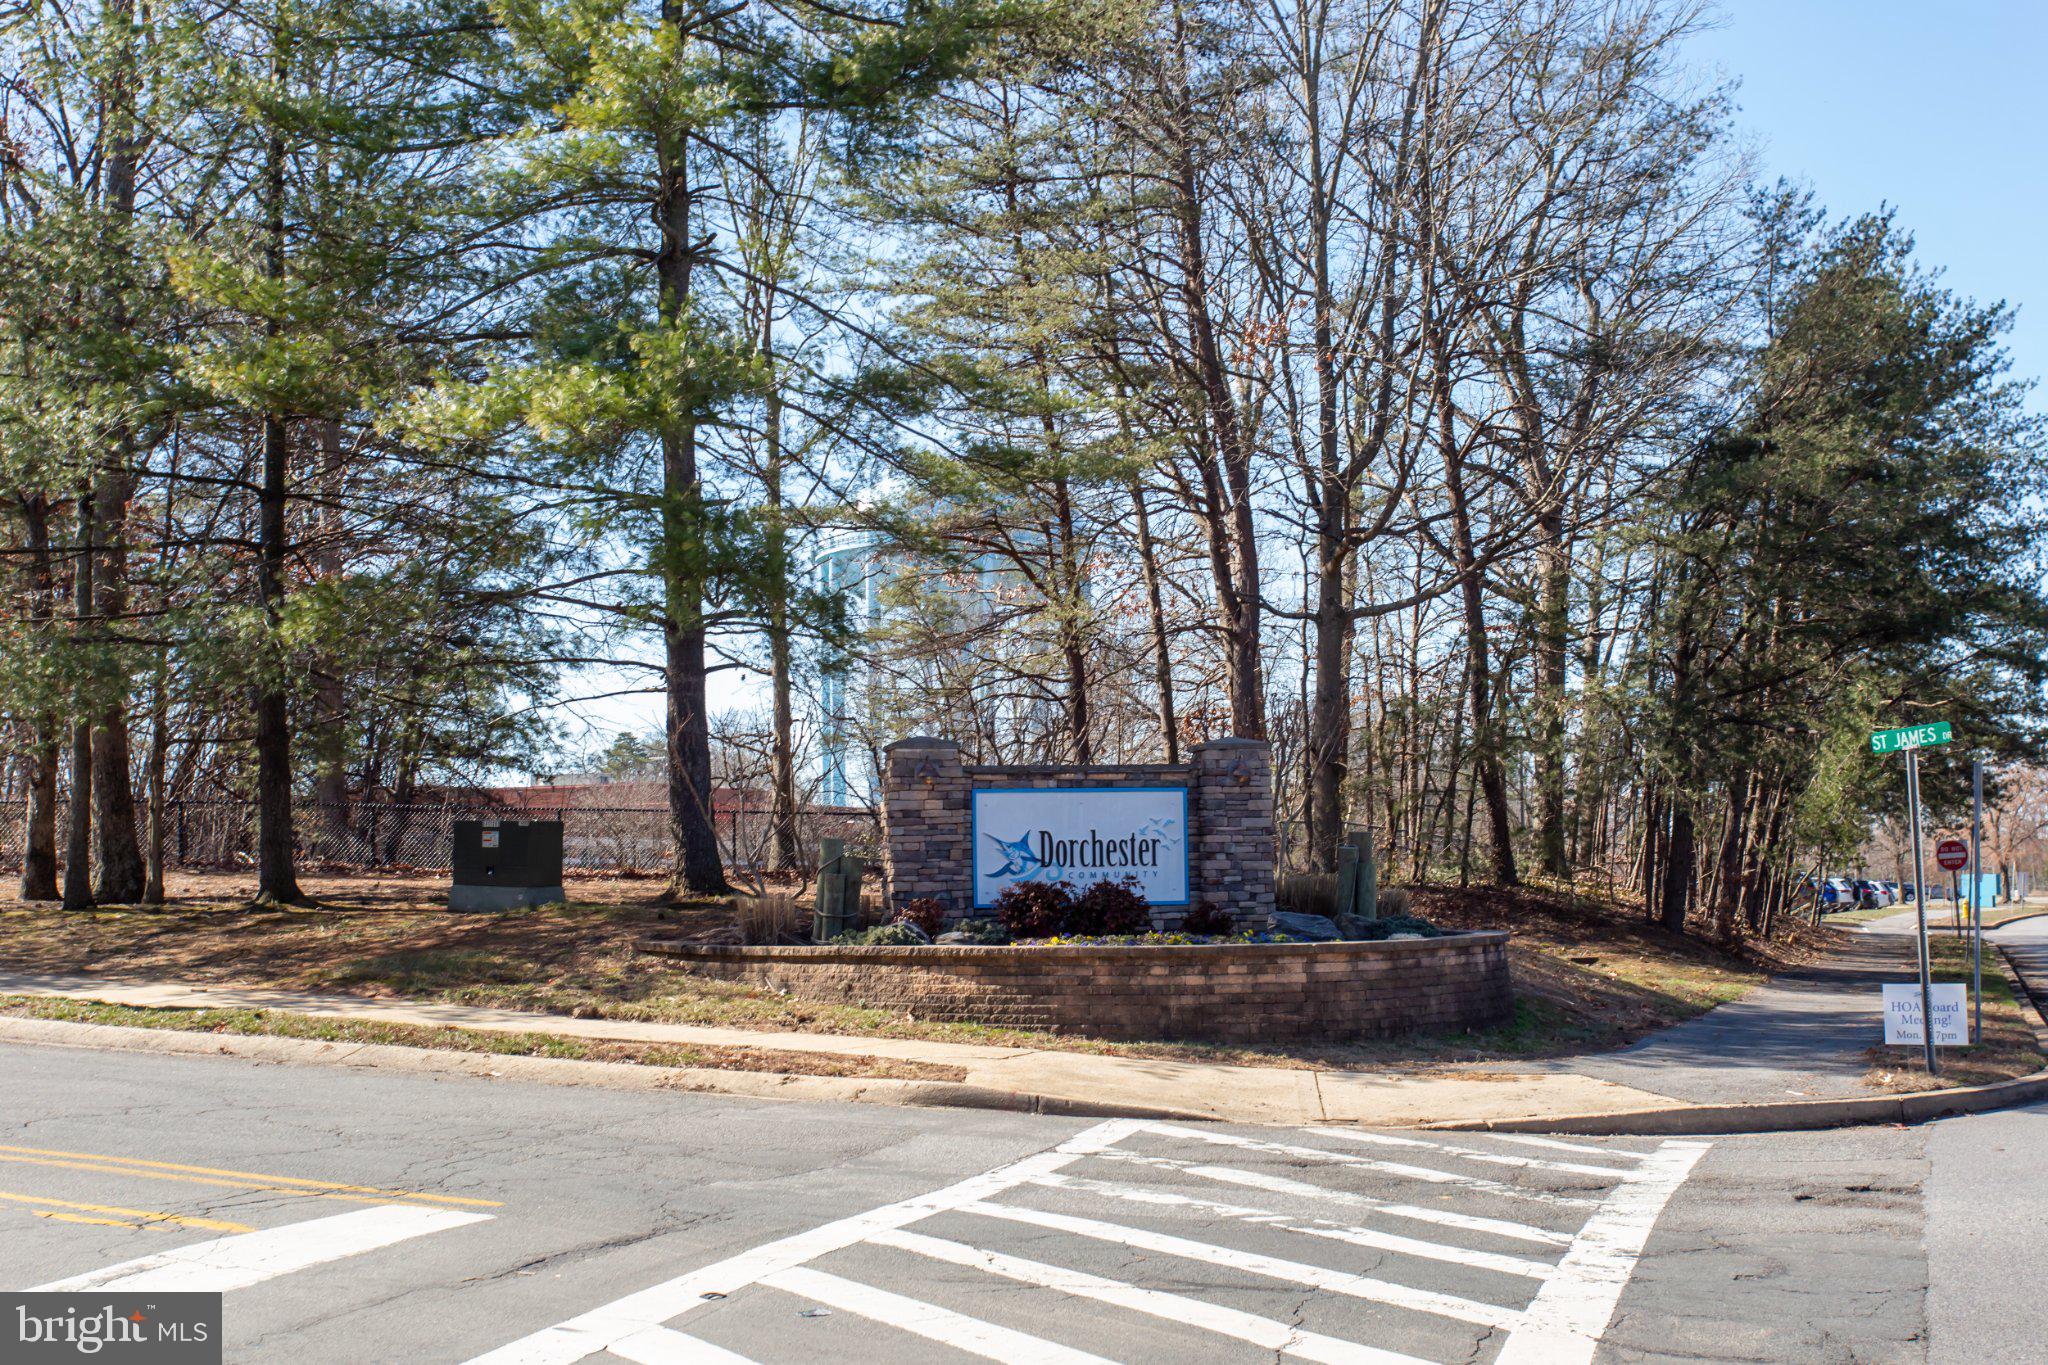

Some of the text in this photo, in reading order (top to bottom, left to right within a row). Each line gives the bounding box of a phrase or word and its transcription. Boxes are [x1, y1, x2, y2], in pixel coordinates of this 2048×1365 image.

[1872, 727, 1952, 750] ST JAMES DR
[1038, 829, 1161, 868] Dorchester
[1068, 870, 1158, 880] COMMUNITY
[1891, 1001, 1959, 1012] HOA oard
[1901, 1014, 1951, 1027] Meeng!
[1896, 1030, 1957, 1042] Mon. 7pm
